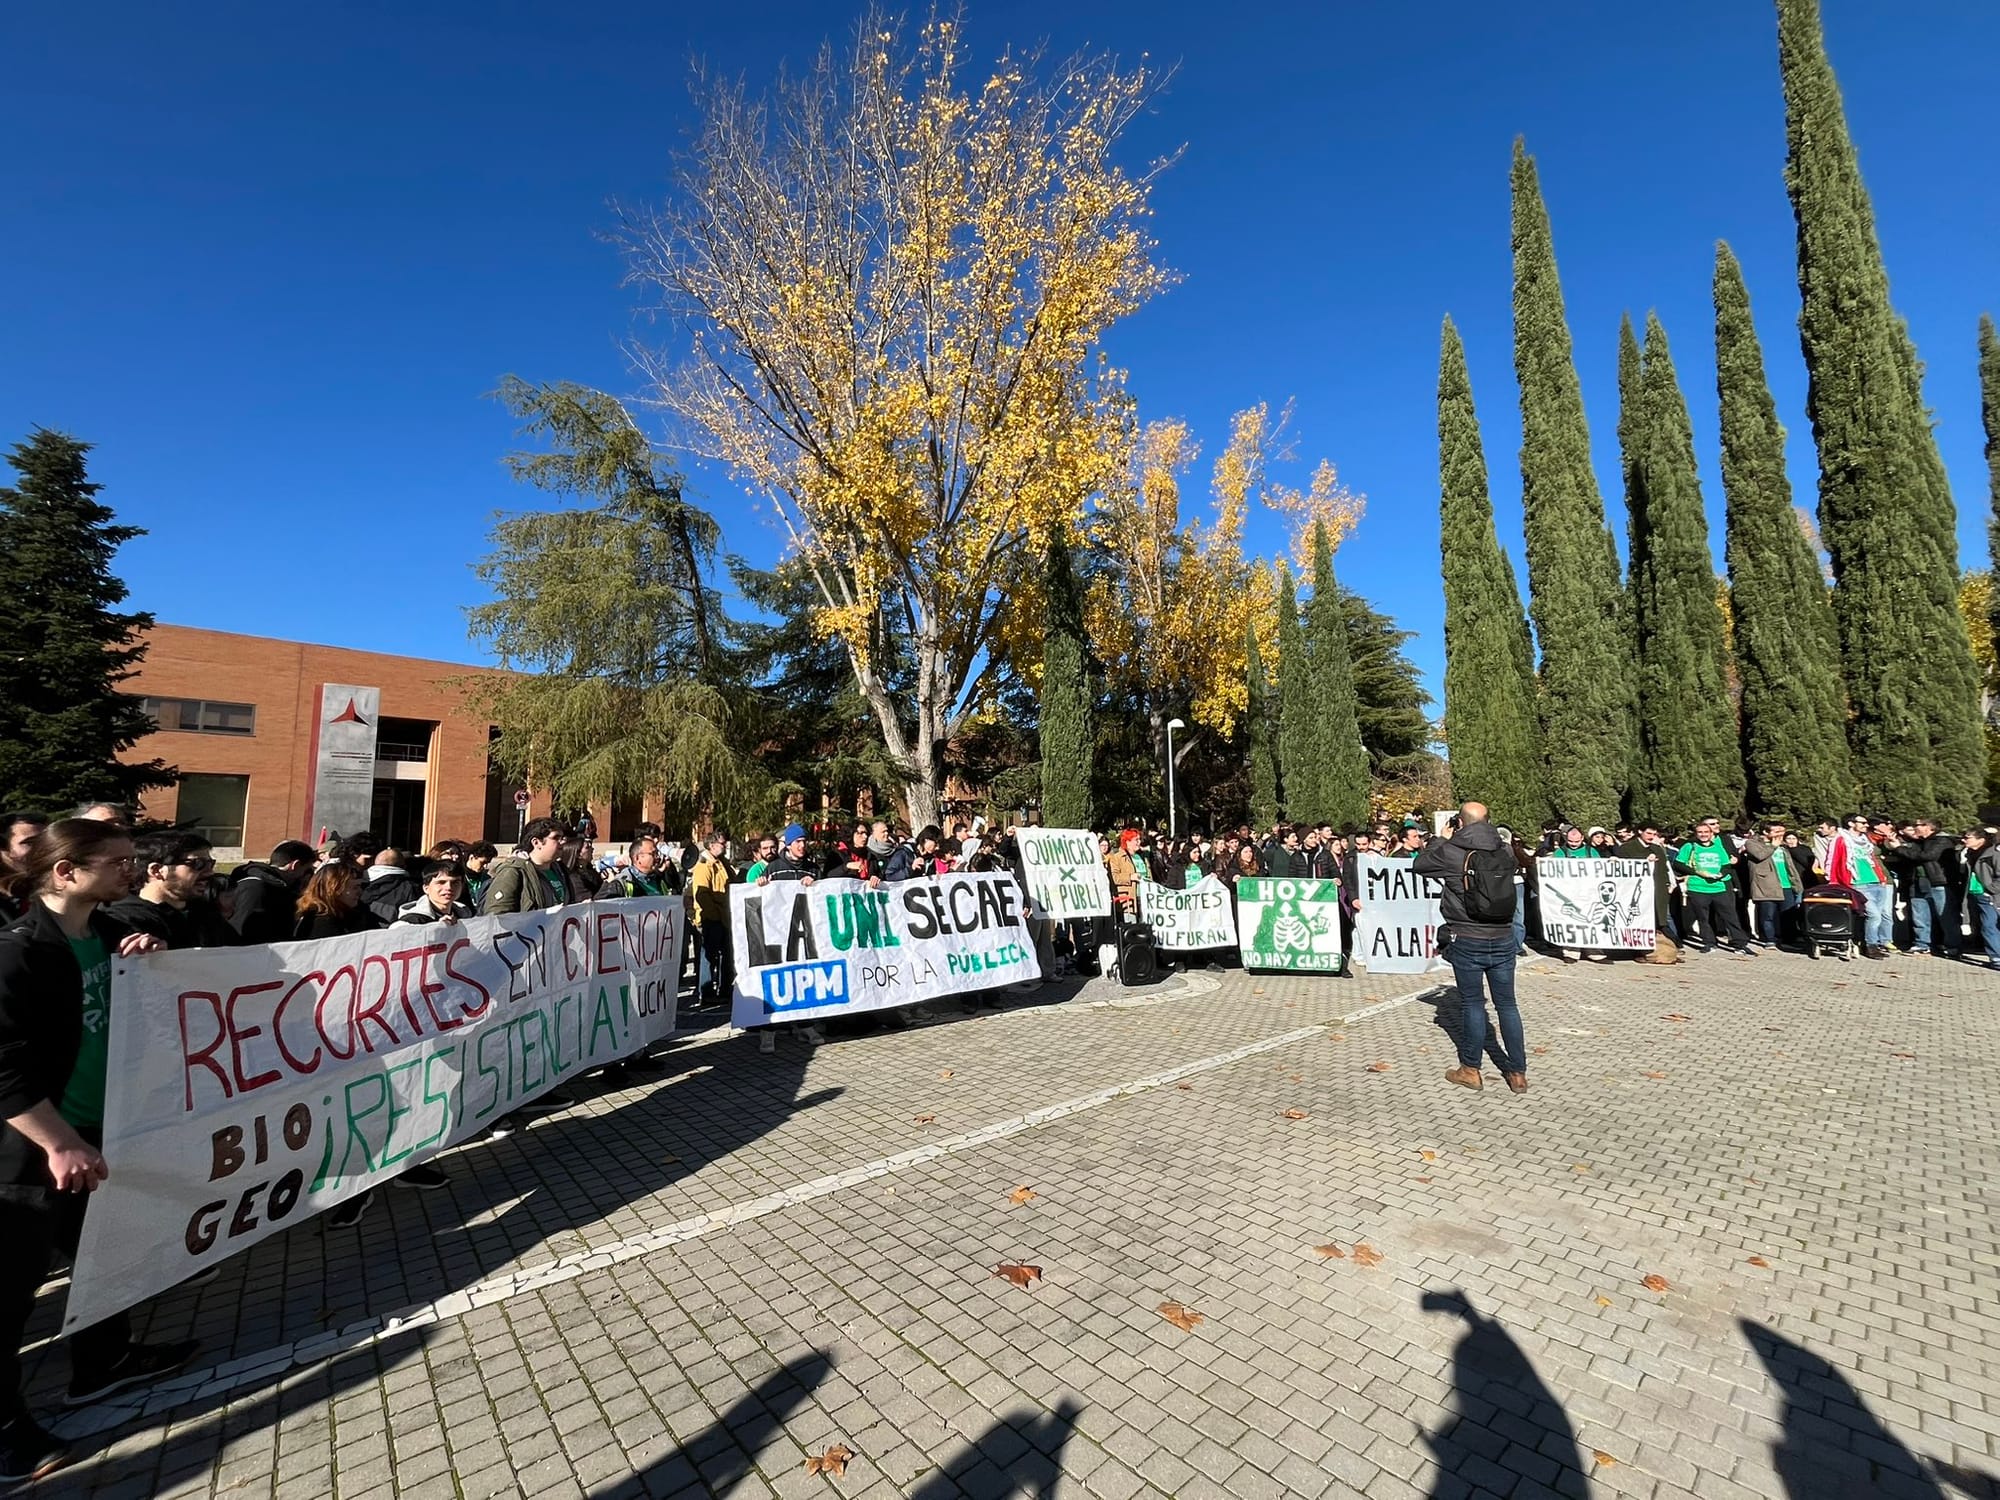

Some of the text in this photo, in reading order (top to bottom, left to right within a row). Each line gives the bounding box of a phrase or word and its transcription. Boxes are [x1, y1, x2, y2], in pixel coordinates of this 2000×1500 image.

[1539, 860, 1564, 878] CON
[1568, 860, 1588, 878] LA
[1035, 884, 1053, 912] LA
[1146, 891, 1222, 911] RECORTES
[1258, 880, 1321, 901] HOY
[744, 893, 819, 968] LA
[825, 892, 901, 951] UNI
[1146, 913, 1176, 928] NOS
[1545, 923, 1599, 945] HASTA
[1620, 928, 1655, 947] MUERTE
[1152, 929, 1227, 946] ULFURAN
[1371, 927, 1392, 958] A
[1396, 927, 1422, 957] LA
[862, 965, 901, 989] POR
[911, 958, 938, 985] LA
[1243, 951, 1340, 969] NO HAY CLASE
[637, 979, 667, 1018] UCM
[769, 964, 844, 1006] UPM
[178, 938, 490, 1111] RECORTES
[493, 925, 546, 1003] EN
[562, 909, 674, 981] CIENCIA
[208, 1102, 312, 1182] BIO
[185, 1168, 303, 1256] GEO
